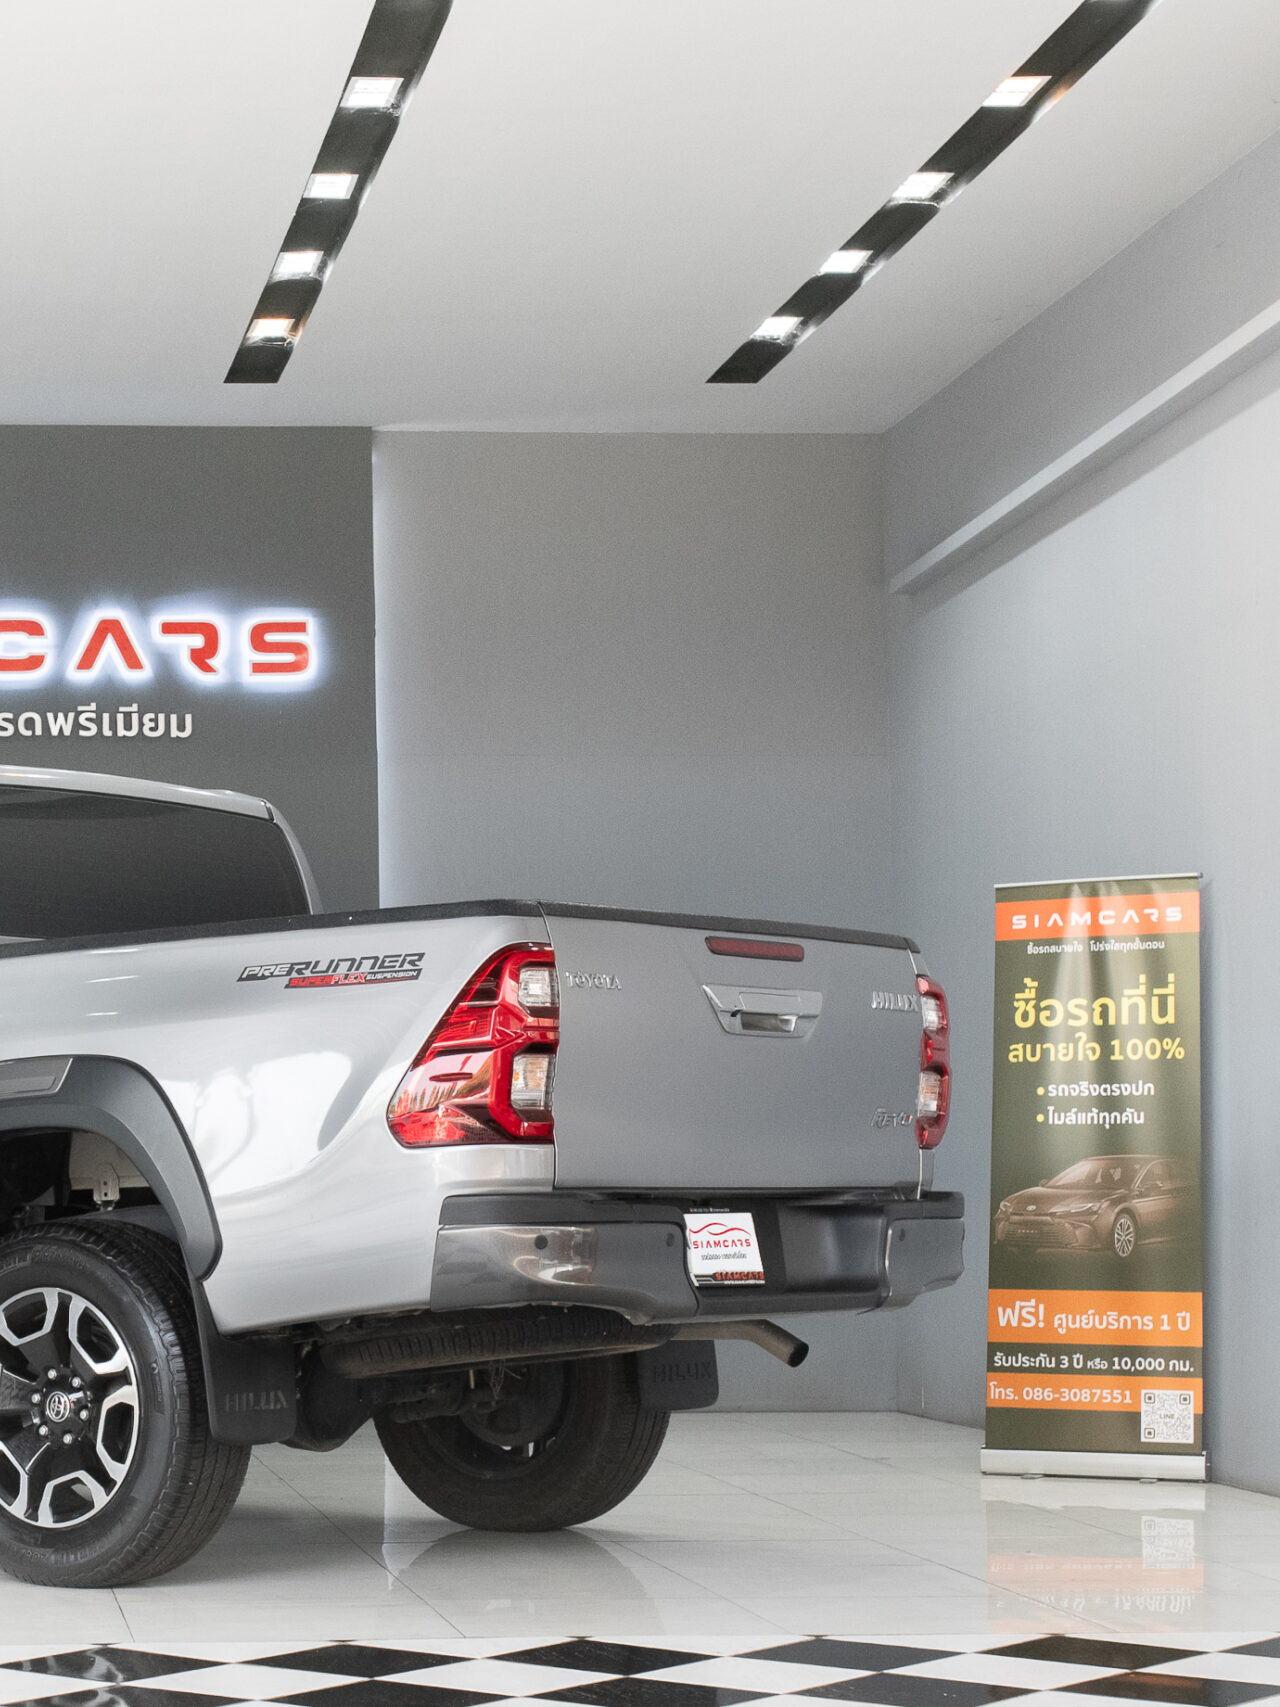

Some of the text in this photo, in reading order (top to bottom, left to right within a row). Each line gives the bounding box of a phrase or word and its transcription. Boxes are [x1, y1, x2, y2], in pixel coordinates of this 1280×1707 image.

[1012, 906, 1182, 929] SIAMCARS
[237, 952, 425, 982] PRERUNNER
[565, 971, 622, 990] TOYOTA
[1013, 973, 1176, 1028] ซื้อรถที่นี่
[1008, 1032, 1186, 1063] สบายใจ 100%
[1048, 1080, 1155, 1098] รถจริงตรงปก
[1047, 1105, 1145, 1129] ไมล์แท้ทุกคัน
[692, 1238, 751, 1249] SIAMCARS
[997, 1298, 1190, 1334] ฟรี! ศูนย์บริการ 1 ปี
[993, 1352, 1056, 1368] รับประกัน
[1059, 1355, 1069, 1368] 3
[1072, 1354, 1084, 1369] ปี
[1112, 1357, 1165, 1372] 10,000
[1169, 1359, 1194, 1372] กม.
[989, 1382, 1133, 1404] โทร. 086-3087551
